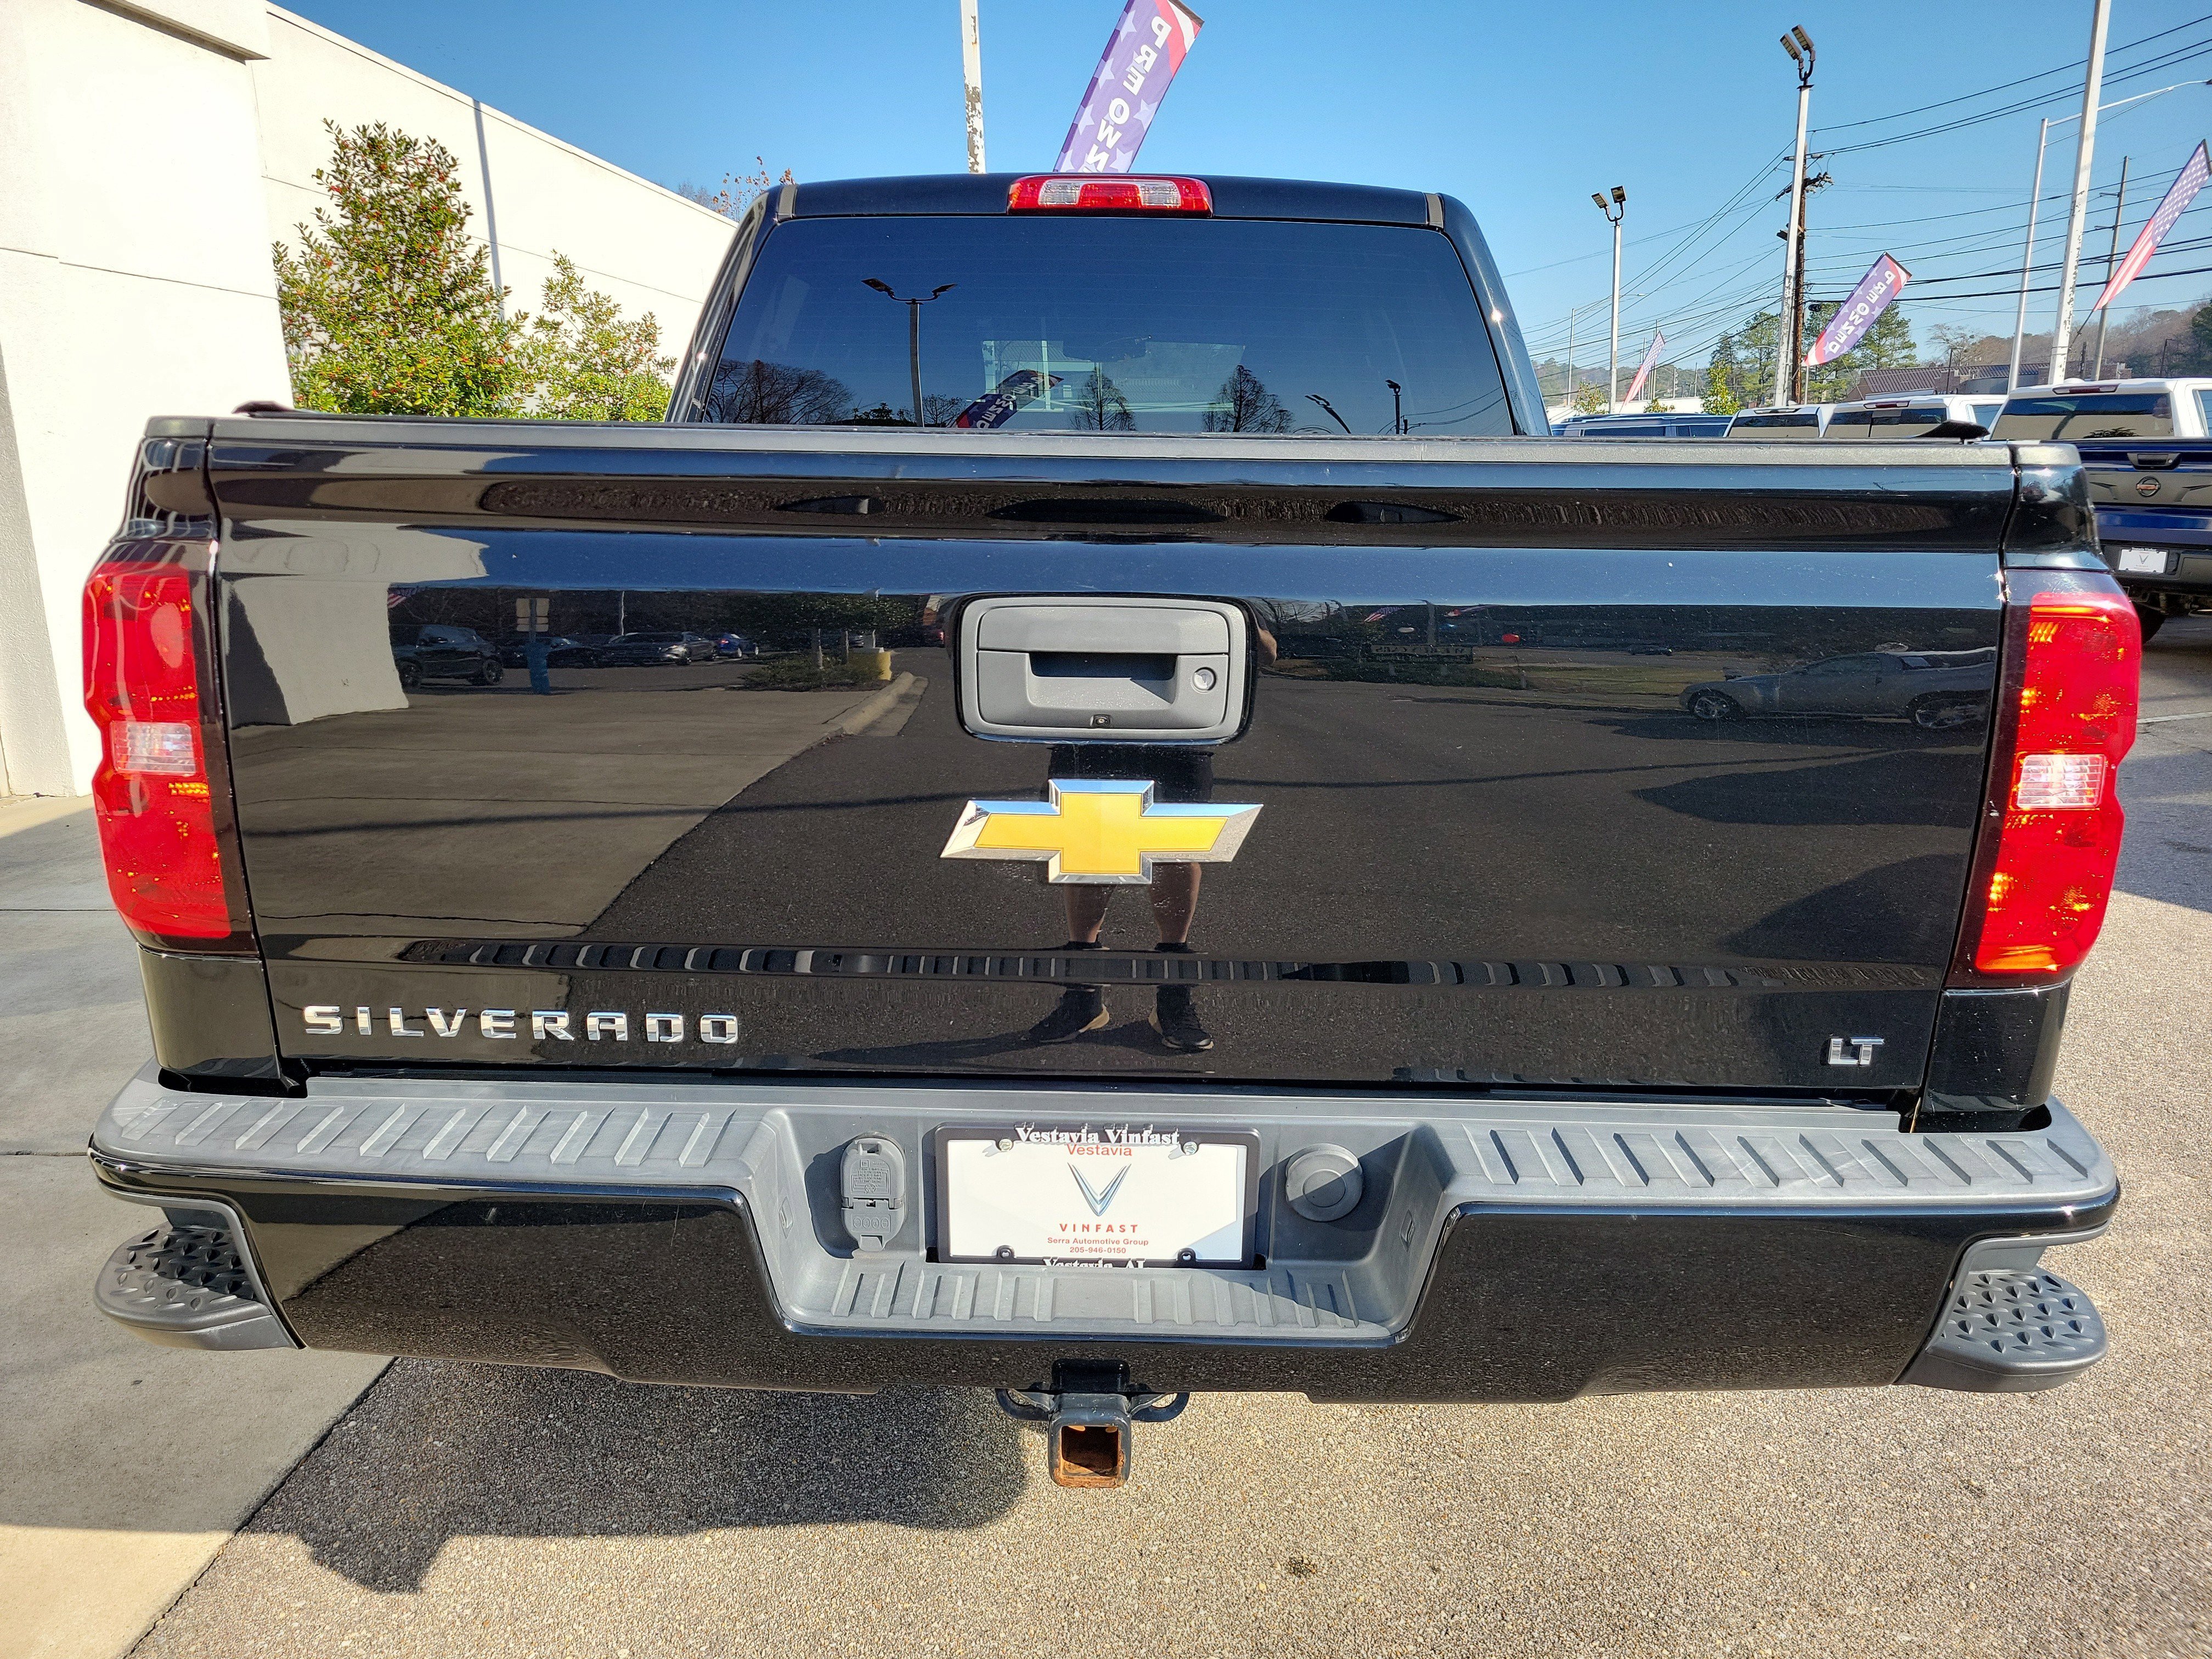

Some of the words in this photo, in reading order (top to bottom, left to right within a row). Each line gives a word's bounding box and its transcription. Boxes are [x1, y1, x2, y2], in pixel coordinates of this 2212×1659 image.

[303, 1005, 739, 1045] SILVERADO
[1827, 1036, 1884, 1067] LT
[1015, 1126, 1099, 1144] Vestavia
[1105, 1127, 1180, 1145] Vinfast
[1067, 1143, 1132, 1156] Vestavia
[1059, 1223, 1138, 1233] VINFAST
